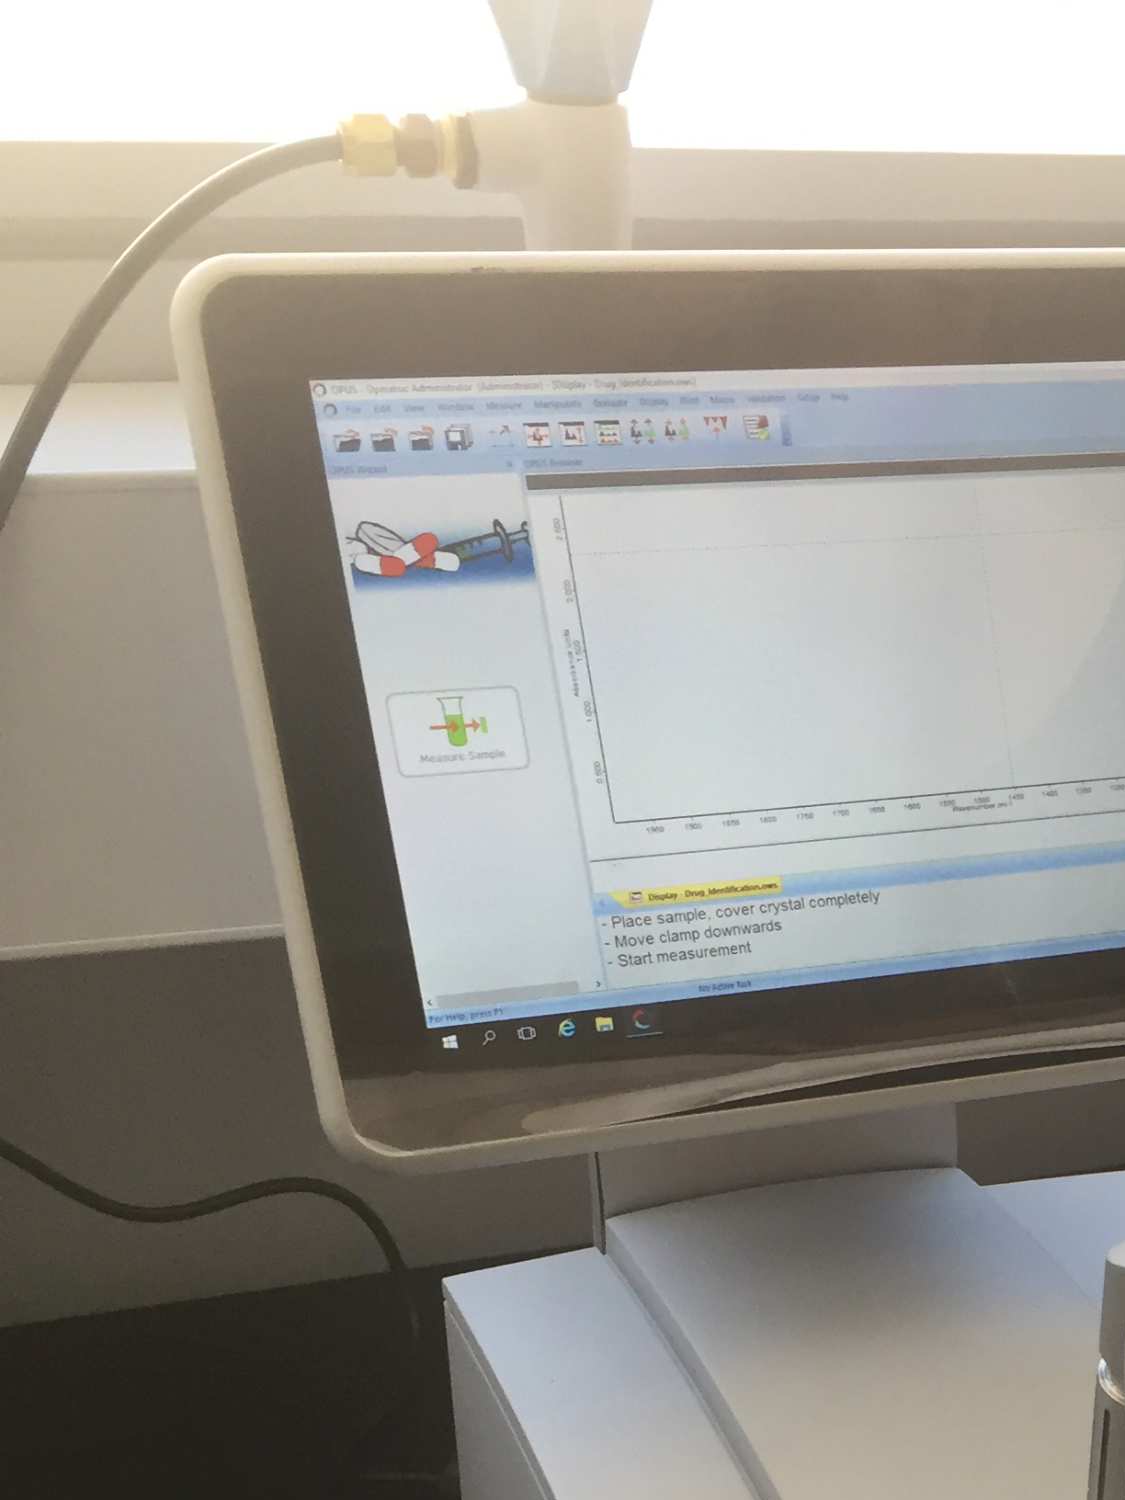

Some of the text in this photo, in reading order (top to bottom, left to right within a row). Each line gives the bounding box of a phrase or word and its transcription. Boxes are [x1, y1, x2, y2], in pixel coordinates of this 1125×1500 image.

[611, 914, 653, 929] Place
[657, 908, 712, 924] sample,
[715, 903, 756, 918] cover
[759, 897, 805, 915] crystal
[809, 890, 881, 909] completely
[614, 934, 655, 949] Move
[659, 929, 701, 944] clamp
[704, 920, 783, 938] downwards
[617, 951, 654, 967] Start
[656, 941, 753, 963] measurement
